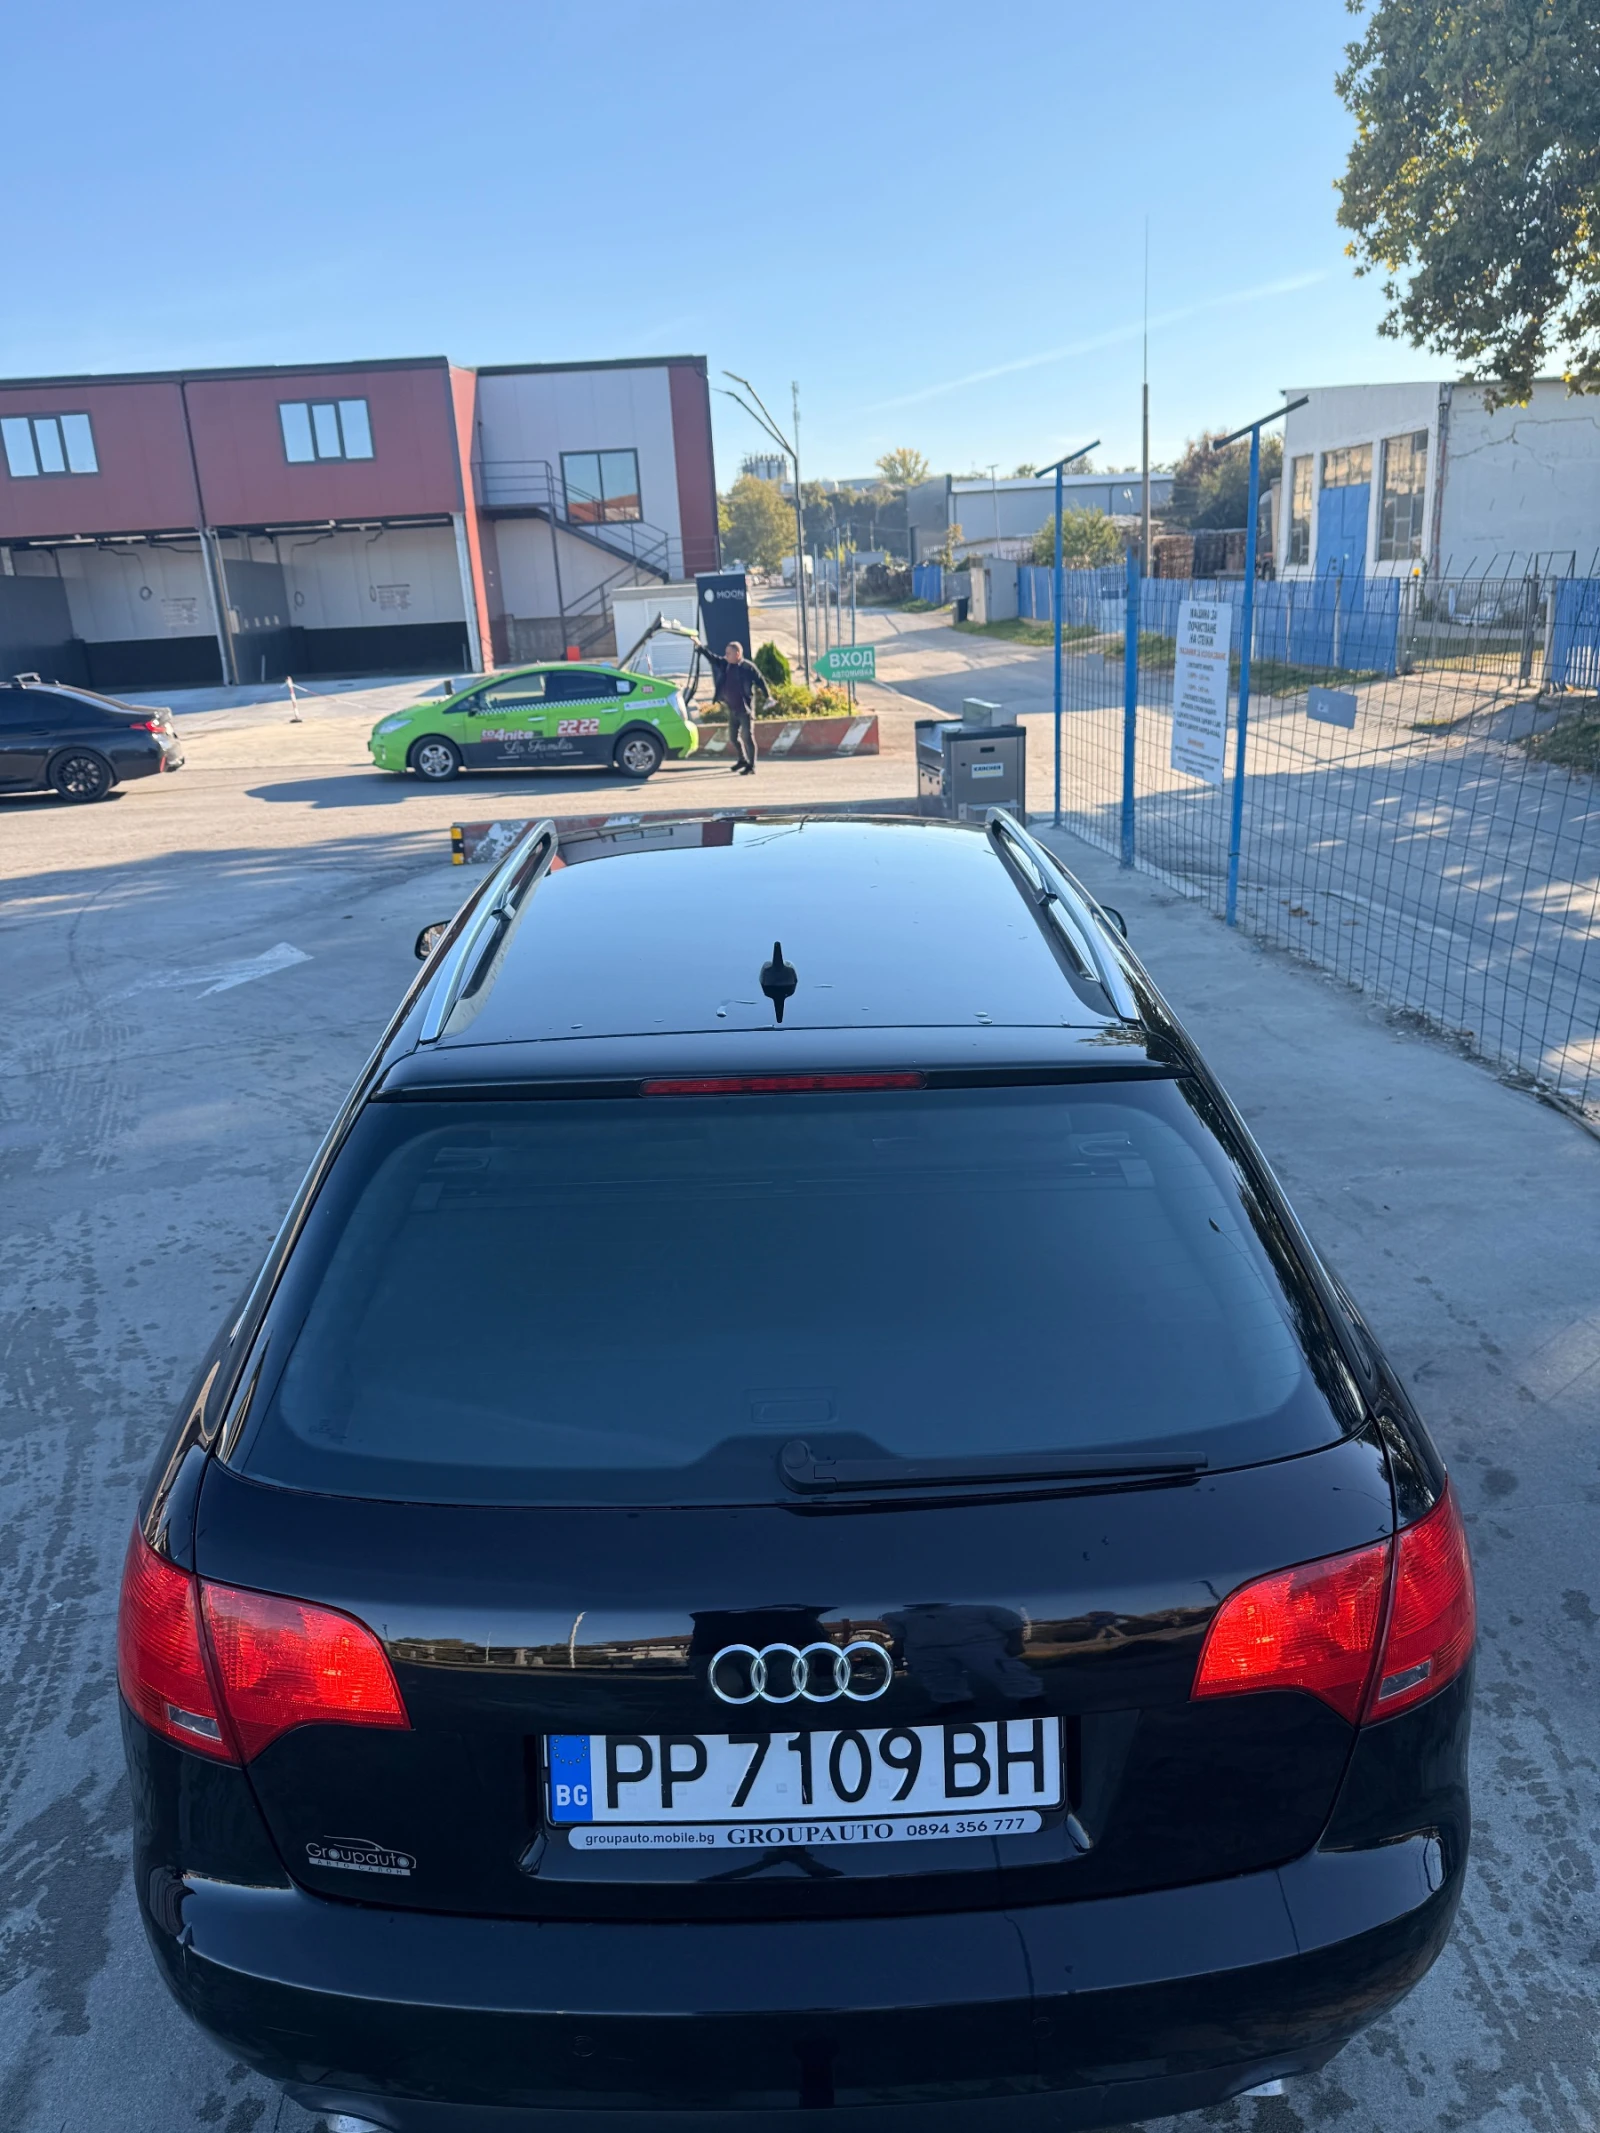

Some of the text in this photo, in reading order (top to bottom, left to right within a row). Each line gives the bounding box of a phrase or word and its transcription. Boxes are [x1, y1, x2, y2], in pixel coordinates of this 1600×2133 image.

[716, 589, 744, 599] MOON
[829, 650, 873, 668] ВХОД
[831, 668, 873, 678] АВТОМИВКА
[605, 1719, 1044, 1809] PP 7109 BH
[556, 1784, 588, 1806] BG
[585, 1818, 1025, 1846] groupauto.mobile.bg GROUPAUTO 0894 356 777
[305, 1842, 410, 1868] Groupauto
